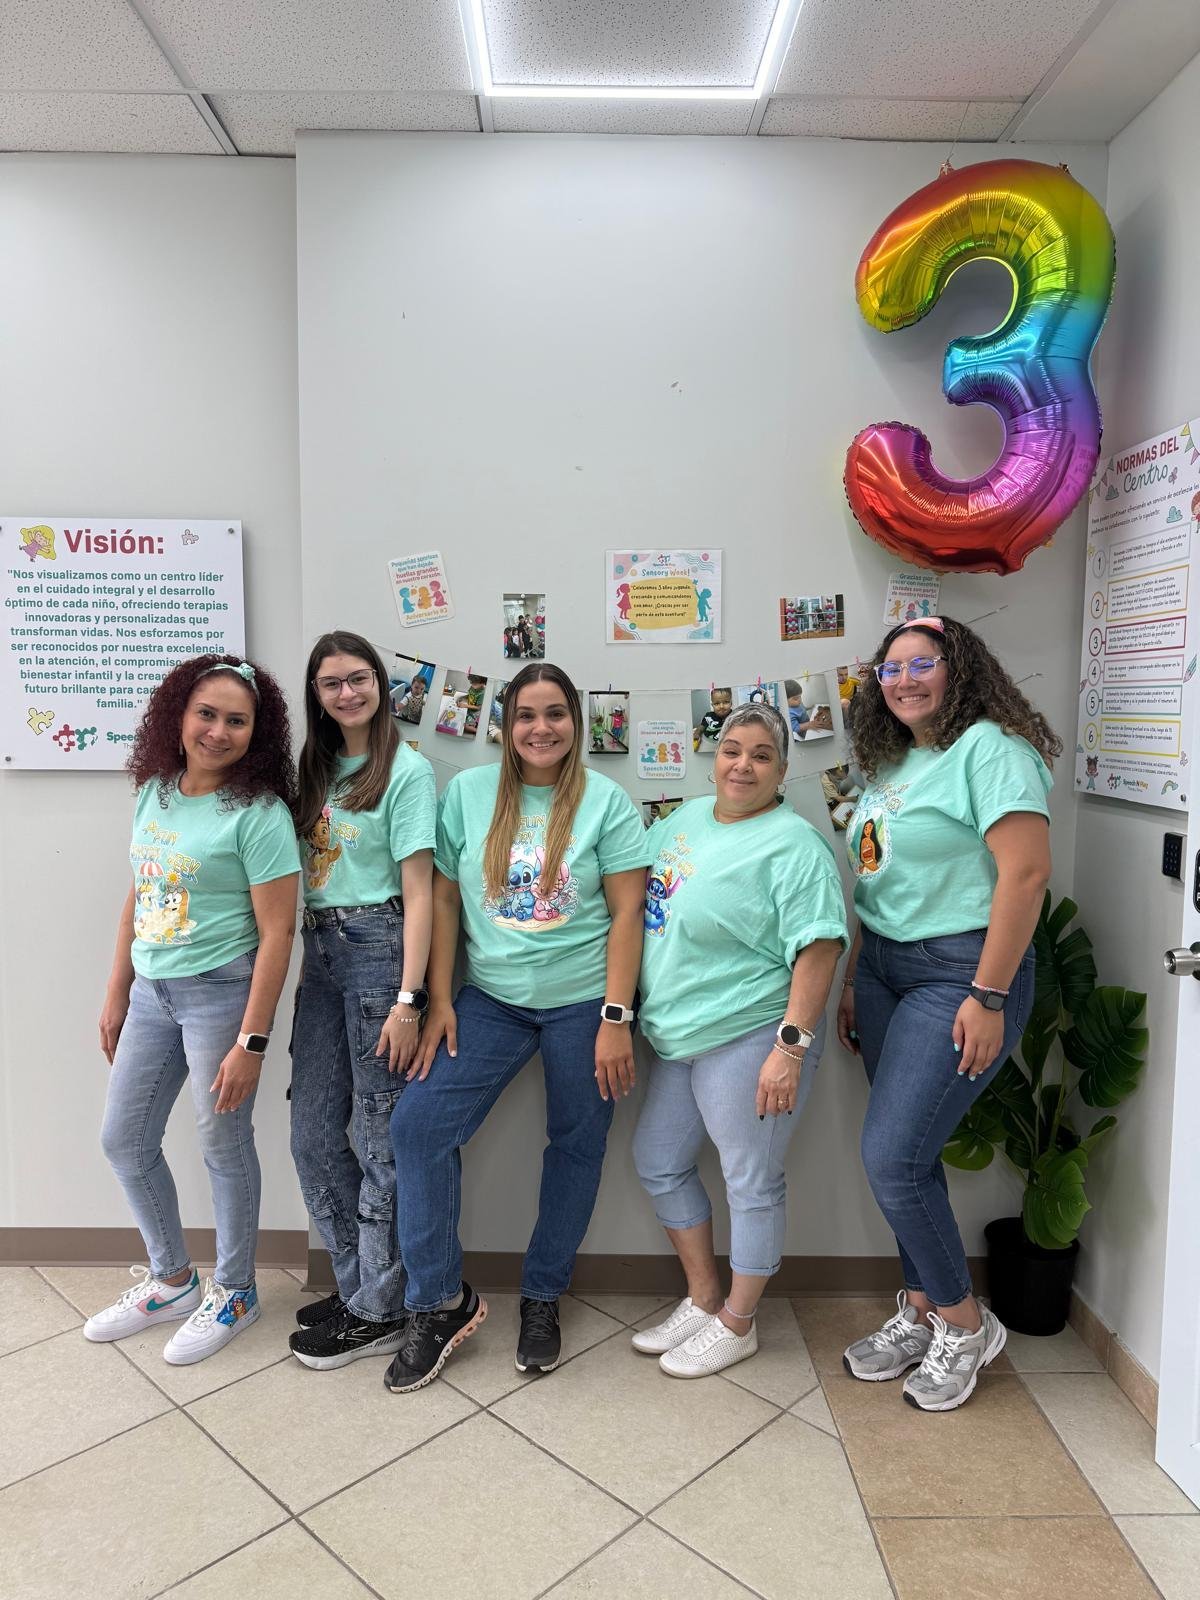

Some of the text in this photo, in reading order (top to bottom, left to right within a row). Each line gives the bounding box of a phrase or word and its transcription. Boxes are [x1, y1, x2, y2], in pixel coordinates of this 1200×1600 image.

[1116, 436, 1179, 475] NORMAS DEL
[1123, 464, 1168, 493] Centro
[64, 529, 164, 554] Visión:
[1098, 558, 1101, 570] 1
[8, 570, 34, 579] "Nos
[37, 570, 108, 580] visualizamos
[160, 572, 196, 581] centro
[199, 572, 224, 582] líder
[642, 568, 690, 577] Sensory Week!
[33, 584, 43, 593] el
[46, 584, 90, 594] cuidado
[92, 584, 135, 597] integral
[138, 588, 144, 597] y
[147, 585, 156, 595] el
[160, 586, 215, 596] desarrollo
[5, 598, 228, 613] óptimo de cada niño, ofreciendo terapias
[1095, 599, 1100, 612] 2
[25, 613, 209, 627] innovadoras y personalizadas que
[10, 627, 224, 642] transforman vidas. Nos esforzamos por
[11, 642, 225, 655] ser reconocidos por nuestra excelencia
[1093, 636, 1098, 649] 3
[36, 656, 45, 665] la
[48, 656, 98, 667] atención,
[102, 656, 111, 666] el
[20, 669, 72, 679] bienestar
[75, 670, 113, 680] infantil
[116, 674, 122, 683] y
[125, 671, 134, 680] la
[1091, 663, 1097, 677] 4
[25, 684, 156, 697] futuro brillante para cad
[96, 698, 143, 709] familia."
[1090, 696, 1095, 709] 5
[1089, 731, 1094, 742] 6
[519, 815, 546, 829] FUN
[956, 1354, 975, 1371] N
